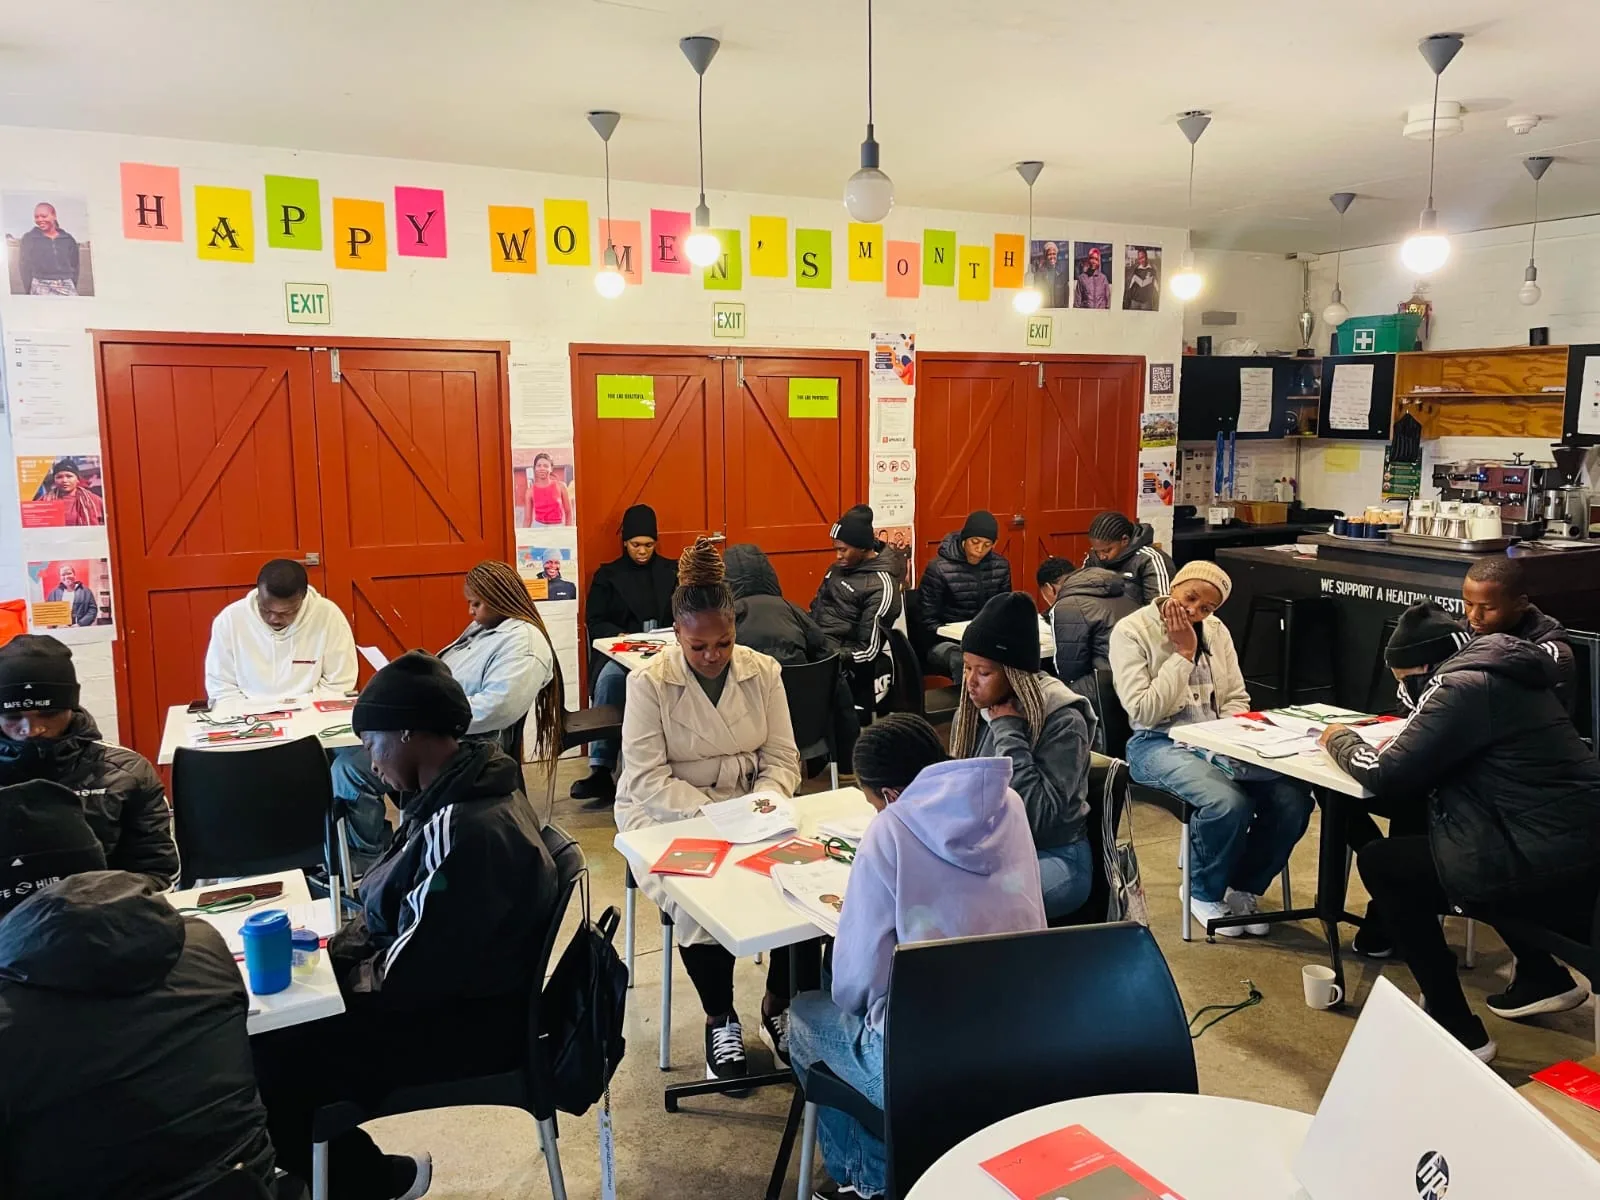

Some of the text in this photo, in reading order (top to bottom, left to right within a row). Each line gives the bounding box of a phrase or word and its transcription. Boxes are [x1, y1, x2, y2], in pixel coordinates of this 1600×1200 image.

[135, 193, 1015, 281] HAPPY WOMEN'S MONTH
[290, 293, 324, 314] EXIT
[717, 311, 742, 329] EXIT
[1030, 323, 1049, 339] EXIT
[1320, 578, 1334, 592] WE
[1336, 581, 1374, 600] SUPPORT
[1376, 587, 1383, 601] A
